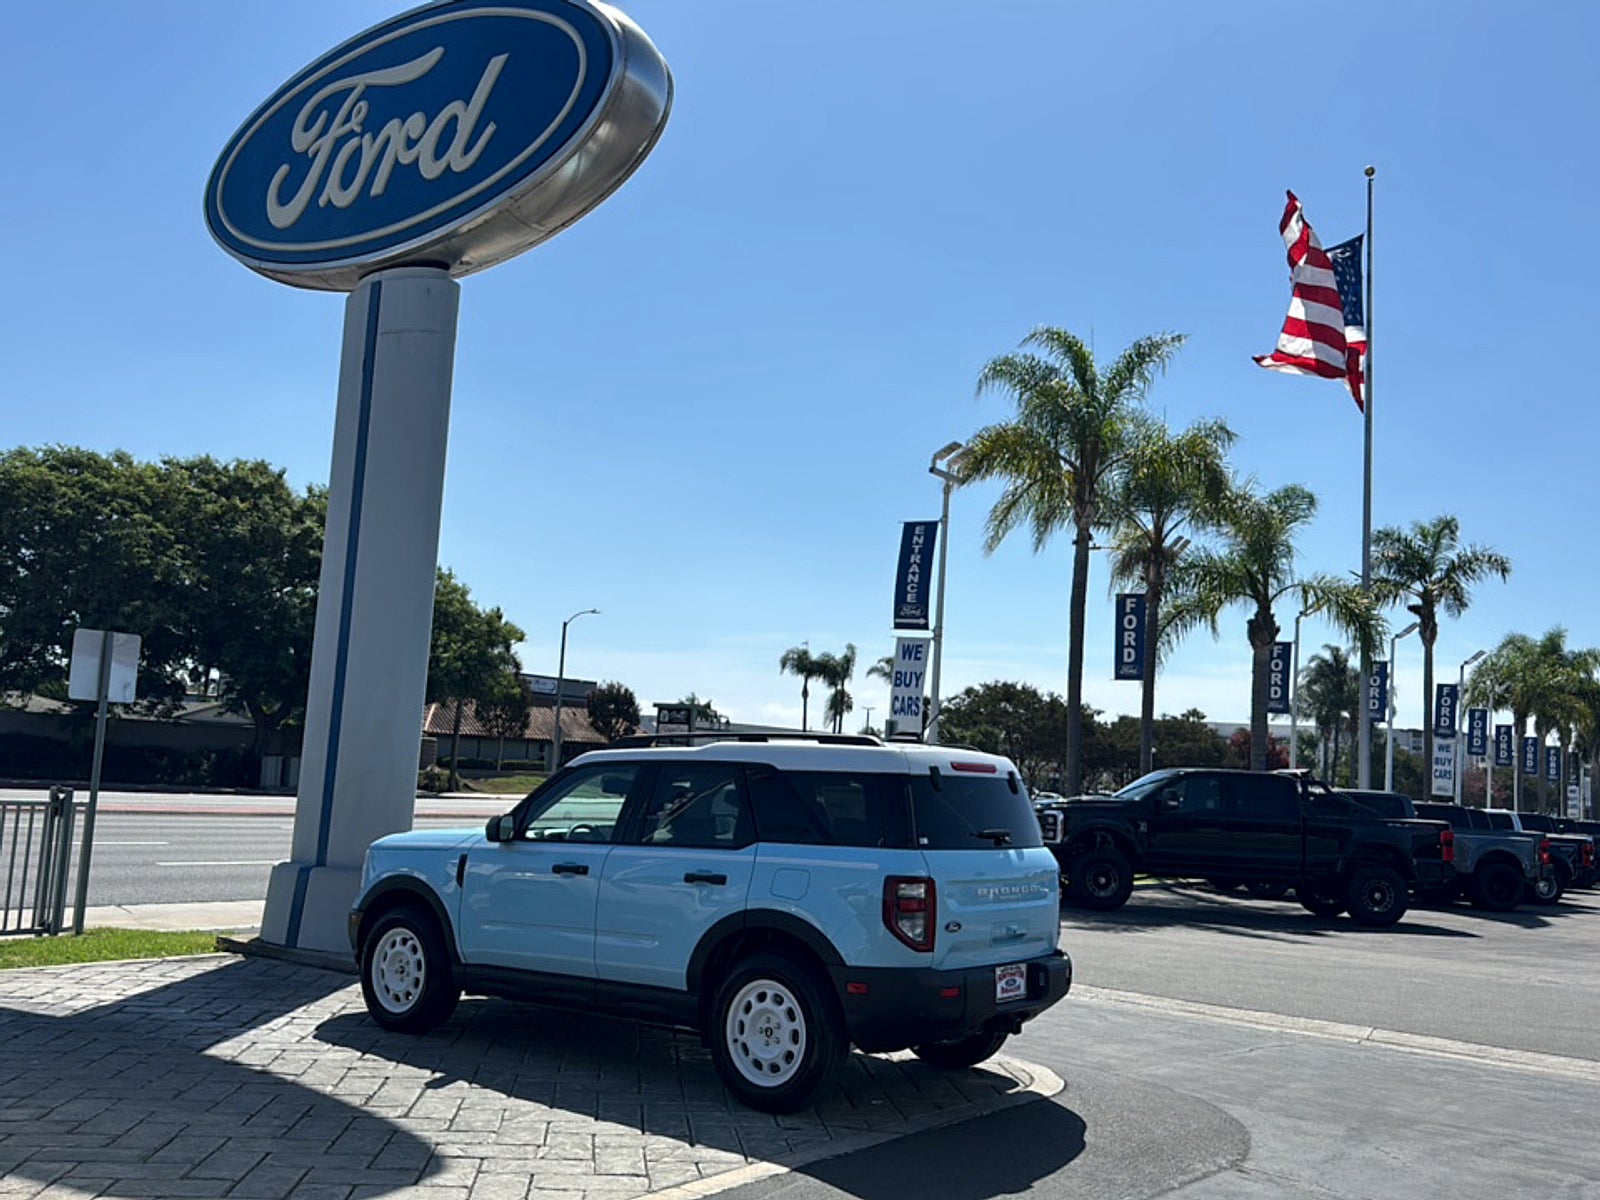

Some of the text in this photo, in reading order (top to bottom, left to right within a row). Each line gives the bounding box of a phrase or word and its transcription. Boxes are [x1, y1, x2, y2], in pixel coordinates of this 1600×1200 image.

[266, 45, 510, 230] Ford
[906, 525, 925, 603] ENTRANCE
[1123, 598, 1137, 663] FORD
[901, 644, 923, 661] WE
[893, 671, 923, 688] BUY
[1270, 645, 1283, 699] FORD
[1369, 663, 1381, 710] FORD
[892, 695, 920, 717] CARS
[1440, 687, 1451, 727] FORD
[1473, 711, 1482, 747] FORD
[1500, 727, 1508, 758] FORD
[1434, 757, 1452, 766] BUY
[1438, 743, 1451, 753] WE
[1433, 769, 1452, 780] CARS
[977, 885, 1041, 896] BRONCO
